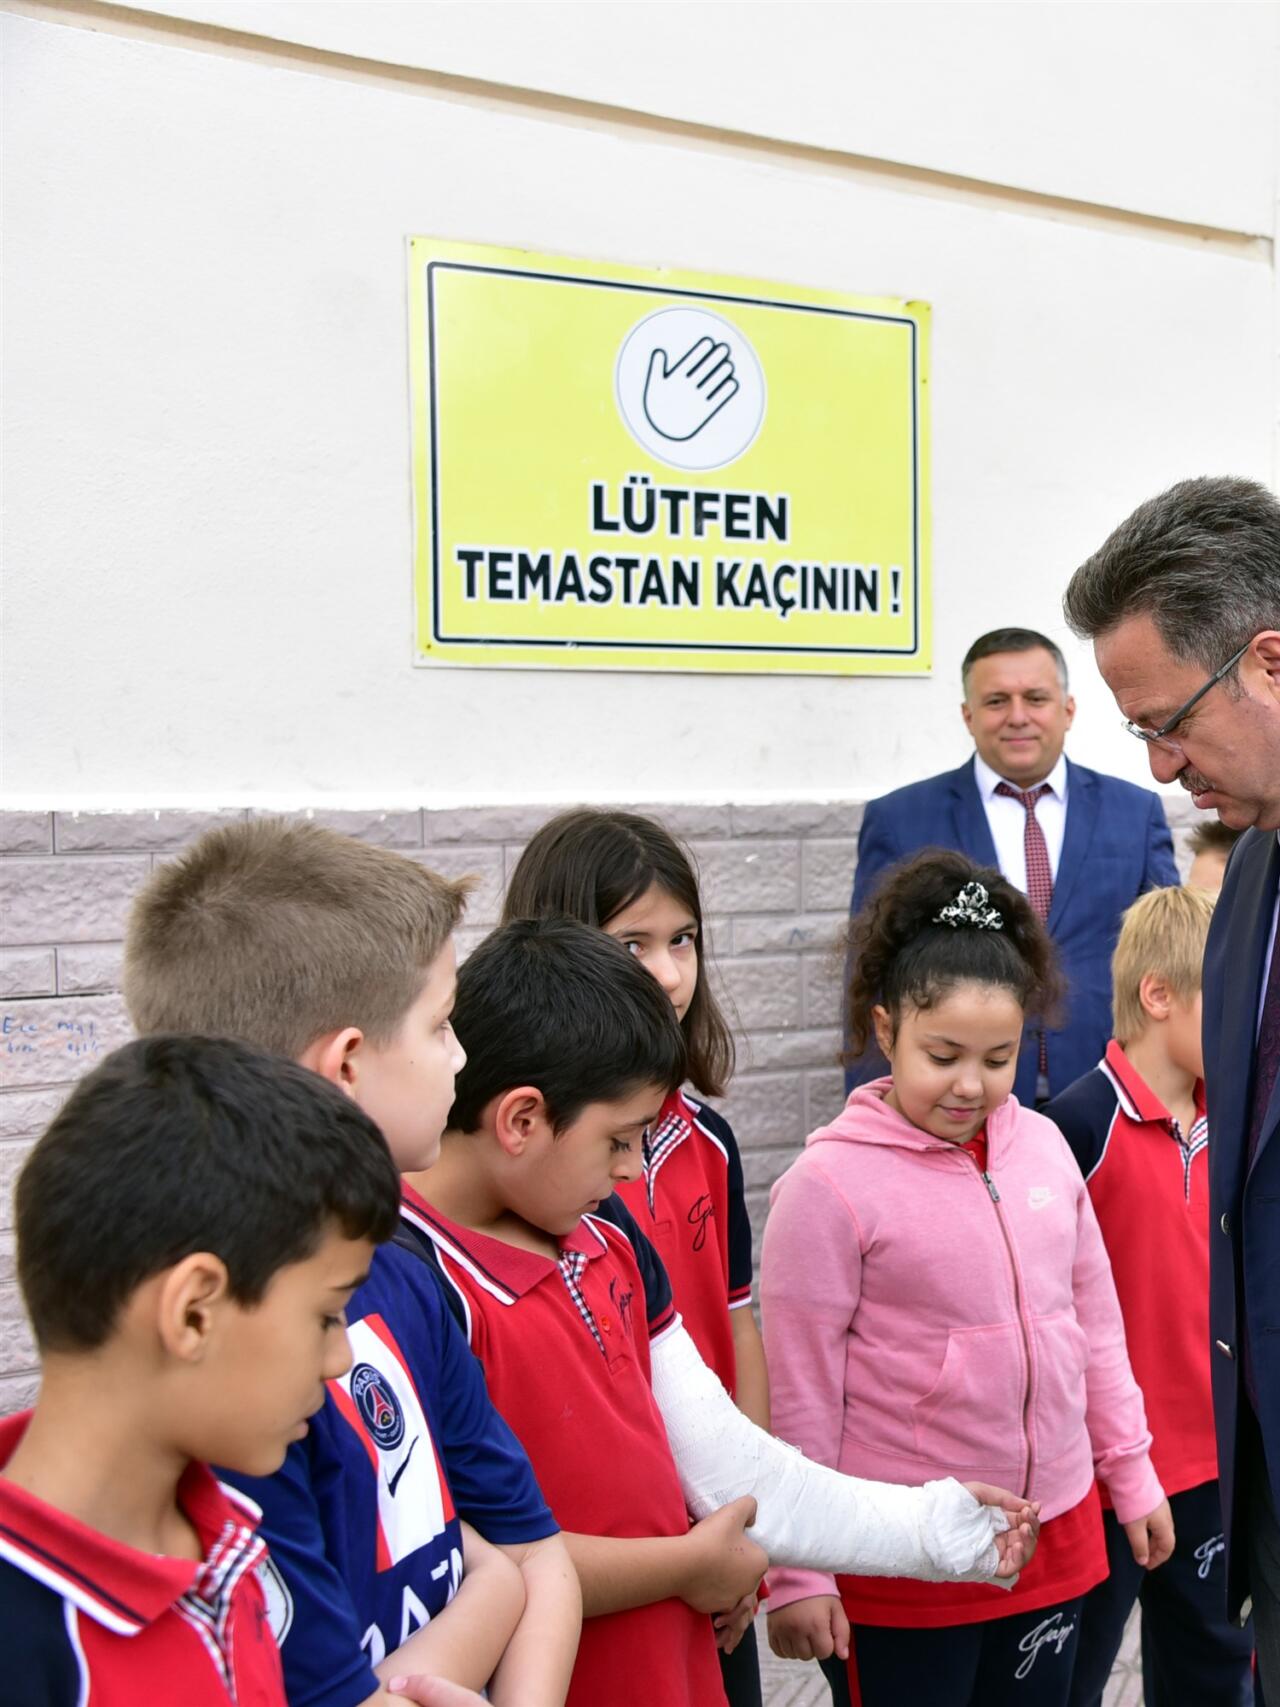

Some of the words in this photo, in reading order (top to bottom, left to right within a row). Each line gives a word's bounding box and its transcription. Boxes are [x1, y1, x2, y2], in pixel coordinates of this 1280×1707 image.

[594, 477, 785, 540] LÜTFEN
[458, 551, 698, 605] TEMASTAN
[718, 563, 877, 616] KAÇININ
